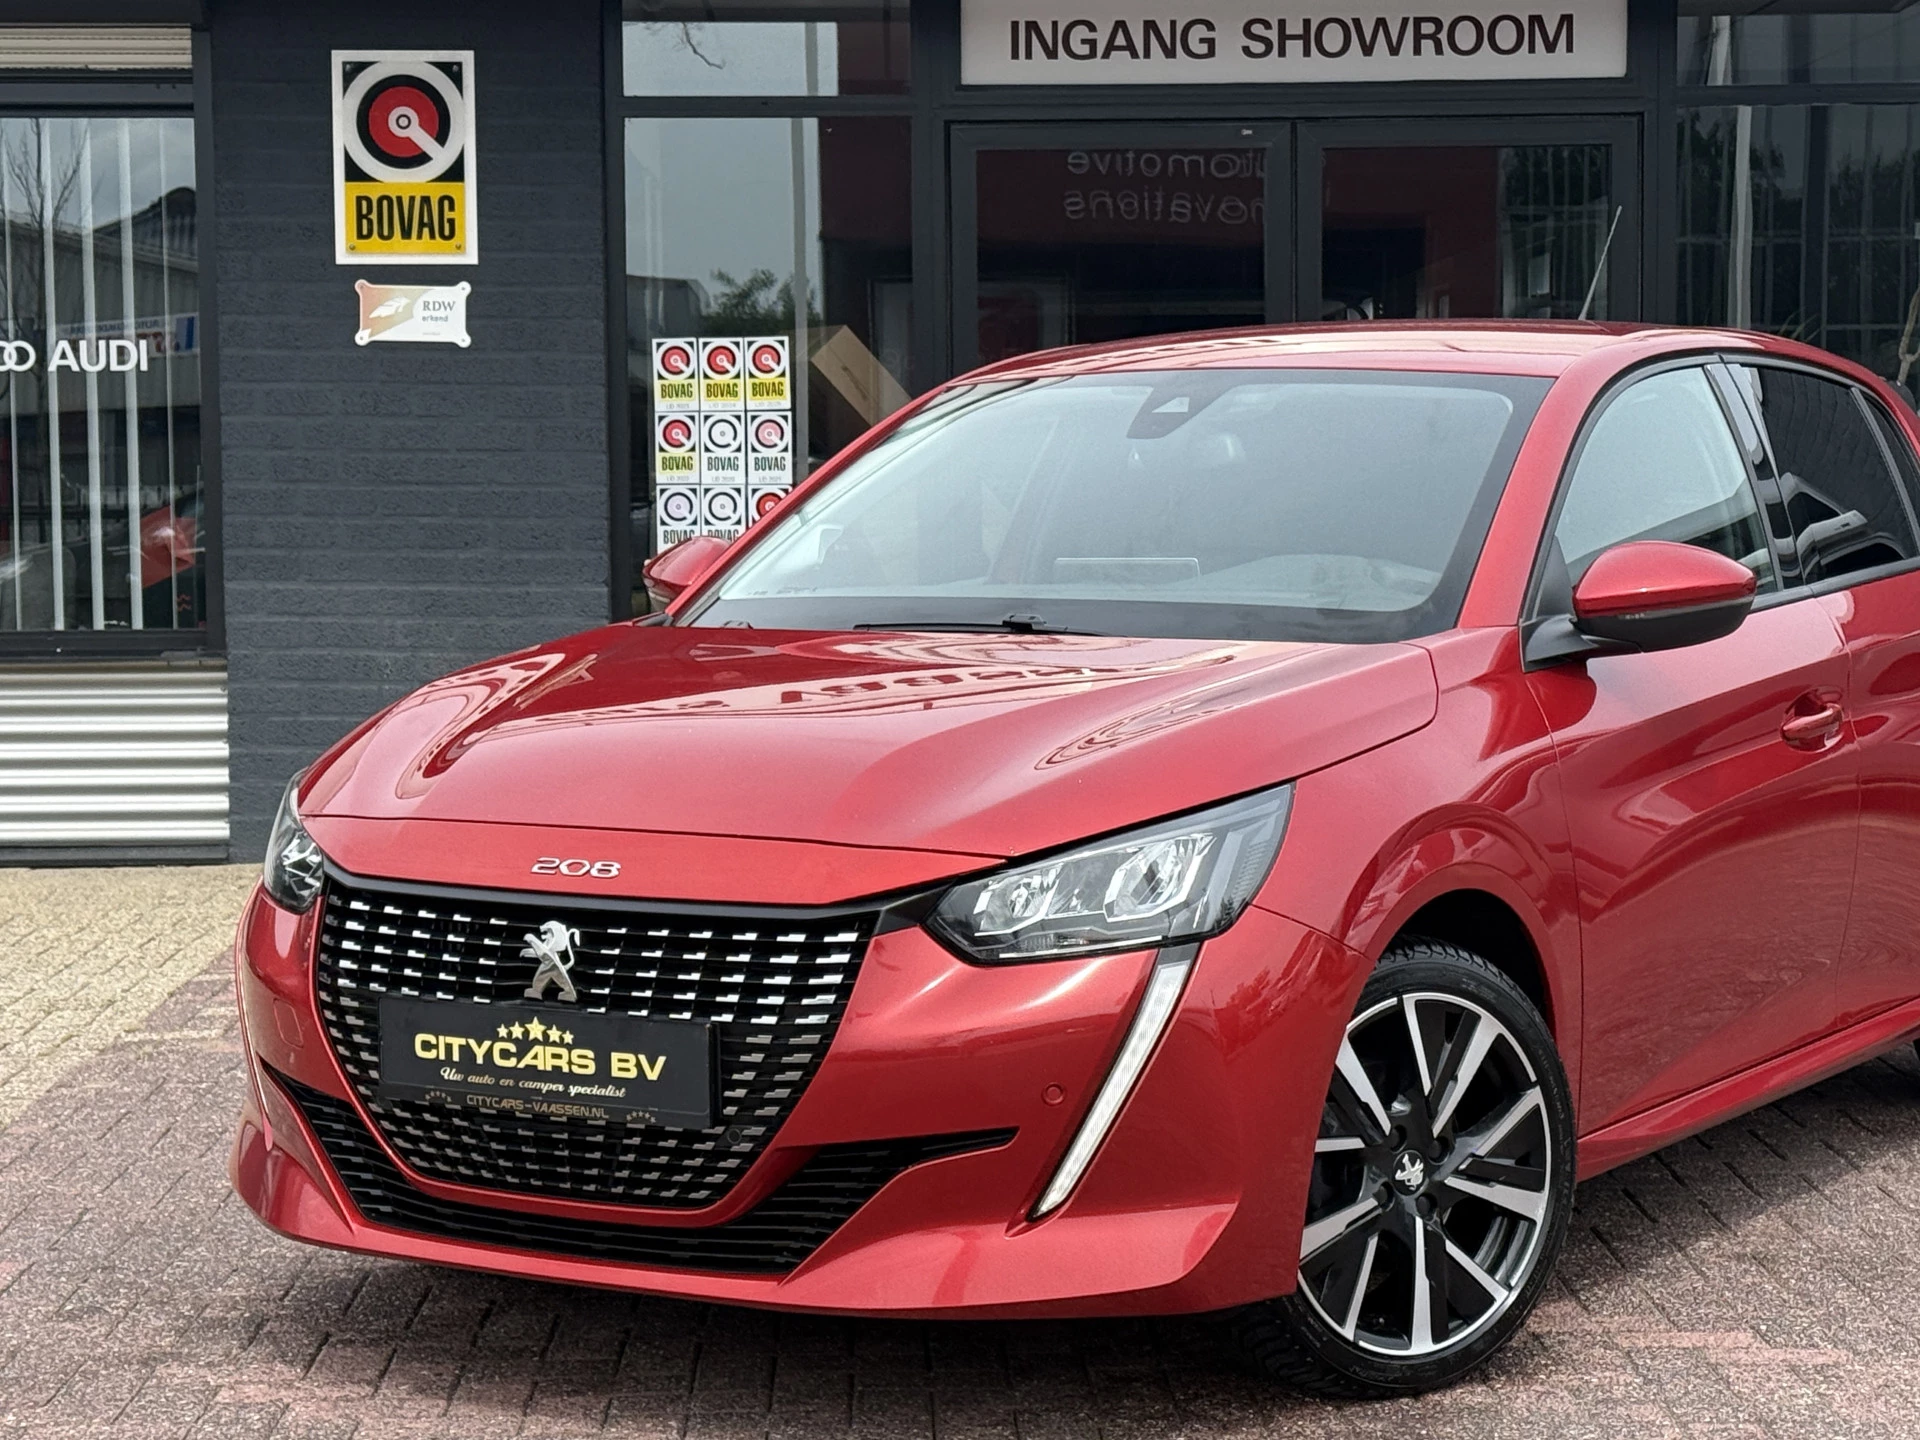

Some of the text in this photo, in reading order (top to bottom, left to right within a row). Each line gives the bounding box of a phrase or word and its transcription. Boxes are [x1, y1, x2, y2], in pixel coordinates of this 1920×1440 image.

[1010, 13, 1575, 61] INGANG SHOWROOM
[355, 195, 456, 242] BOVAG
[422, 300, 456, 312] RDW
[48, 339, 149, 372] AUDI
[661, 382, 693, 399] BOVAG
[706, 382, 738, 398] BOVAG
[752, 381, 784, 397] BOVAG
[662, 456, 693, 471] BOVAG
[707, 456, 739, 471] BOVAG
[754, 456, 786, 471] BOVAG
[530, 857, 621, 878] 208
[414, 1033, 667, 1081] CITYCARS BV
[440, 1066, 627, 1098] Uw auto en camper specialist
[466, 1094, 609, 1119] CITYCARS-VAASSEN.NL
